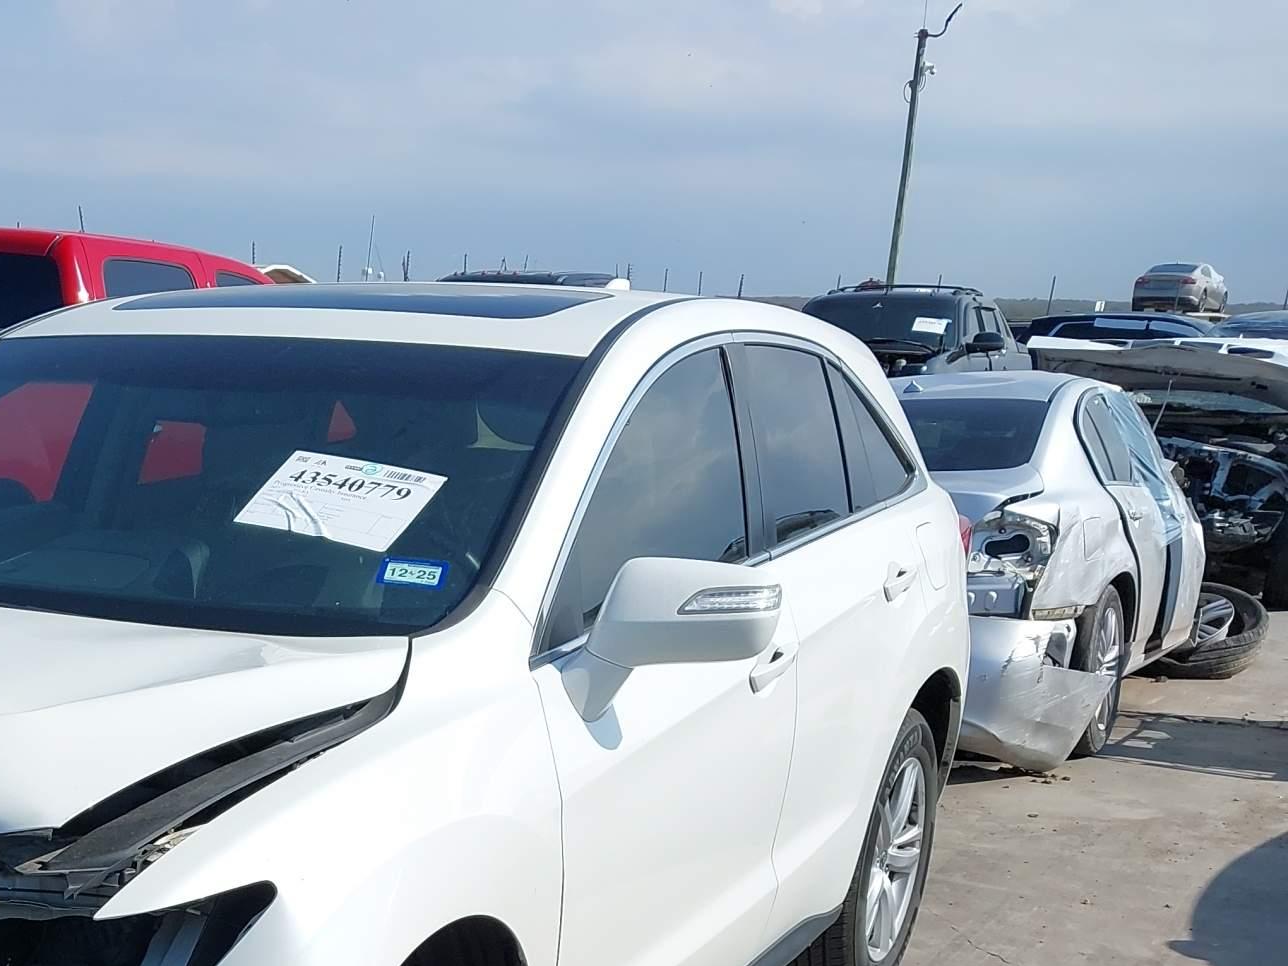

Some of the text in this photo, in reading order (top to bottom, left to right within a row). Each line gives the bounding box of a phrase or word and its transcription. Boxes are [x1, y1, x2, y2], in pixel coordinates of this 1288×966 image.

[288, 467, 412, 501] 43540779
[389, 567, 437, 581] 12 25
